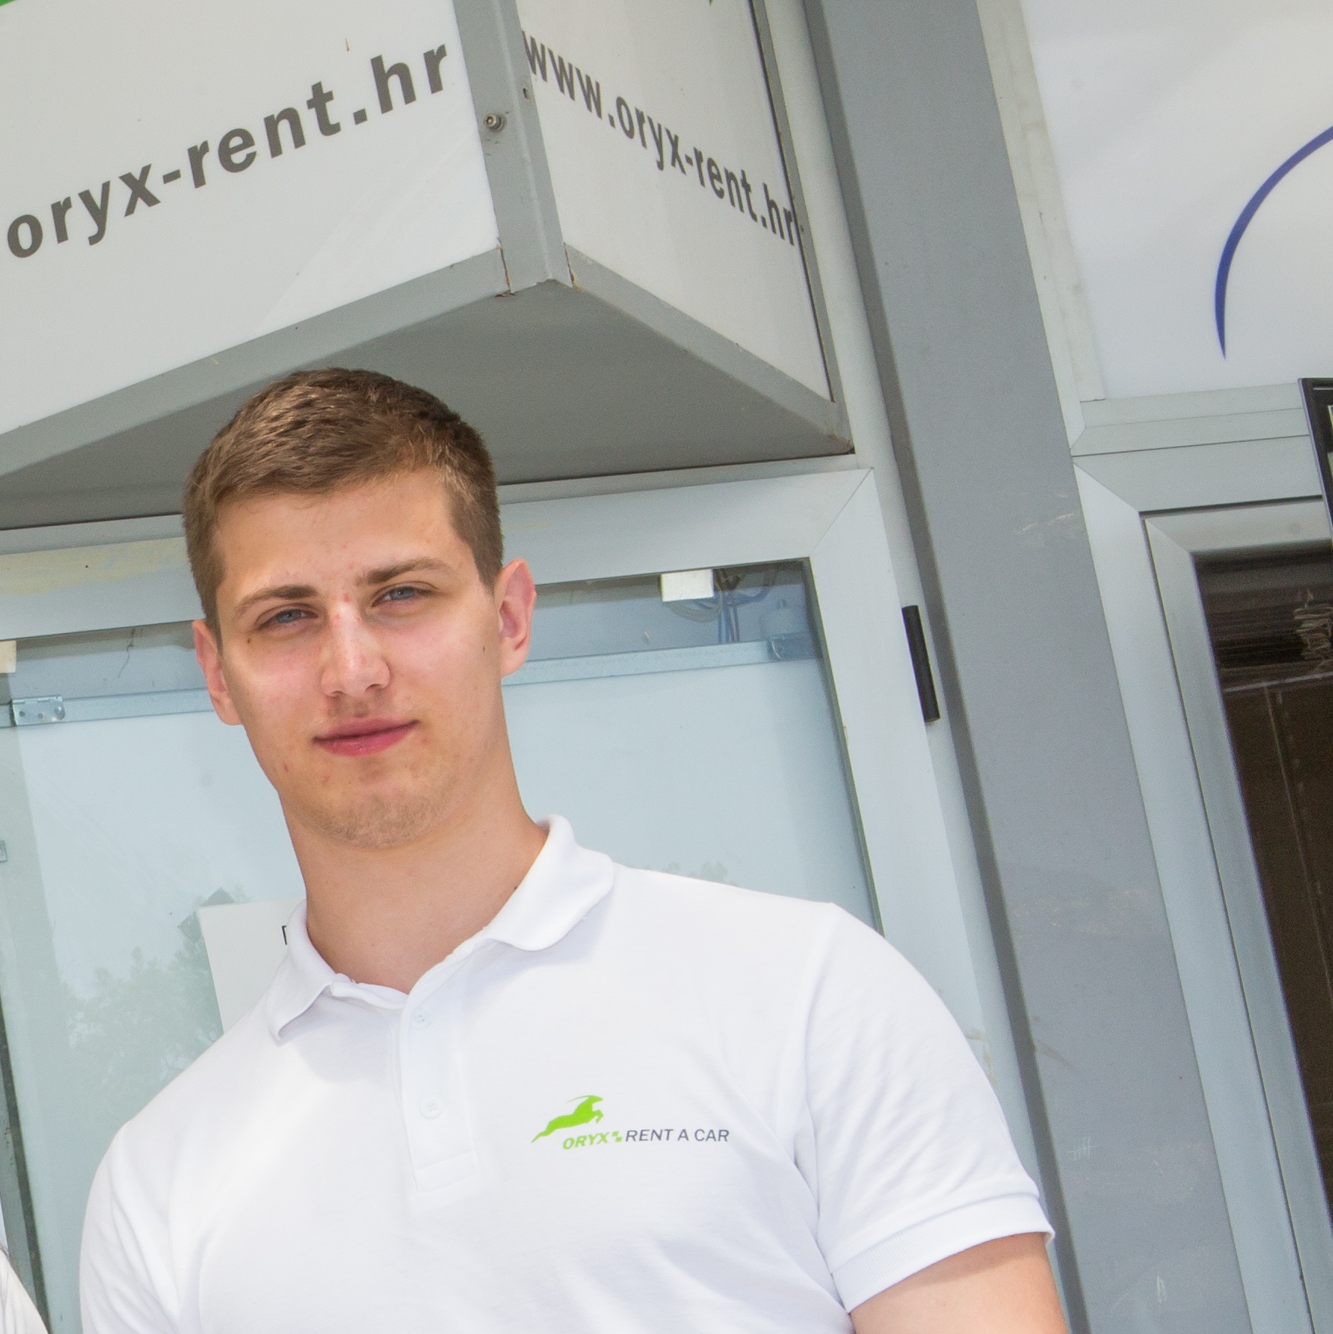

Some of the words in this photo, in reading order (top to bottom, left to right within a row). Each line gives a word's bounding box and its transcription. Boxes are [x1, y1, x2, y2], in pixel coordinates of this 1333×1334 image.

[521, 30, 795, 247] www.oryx-rent.hr
[562, 1131, 610, 1150] ORYX
[625, 1128, 674, 1142] RENT
[677, 1129, 689, 1142] A
[694, 1128, 730, 1142] CAR
